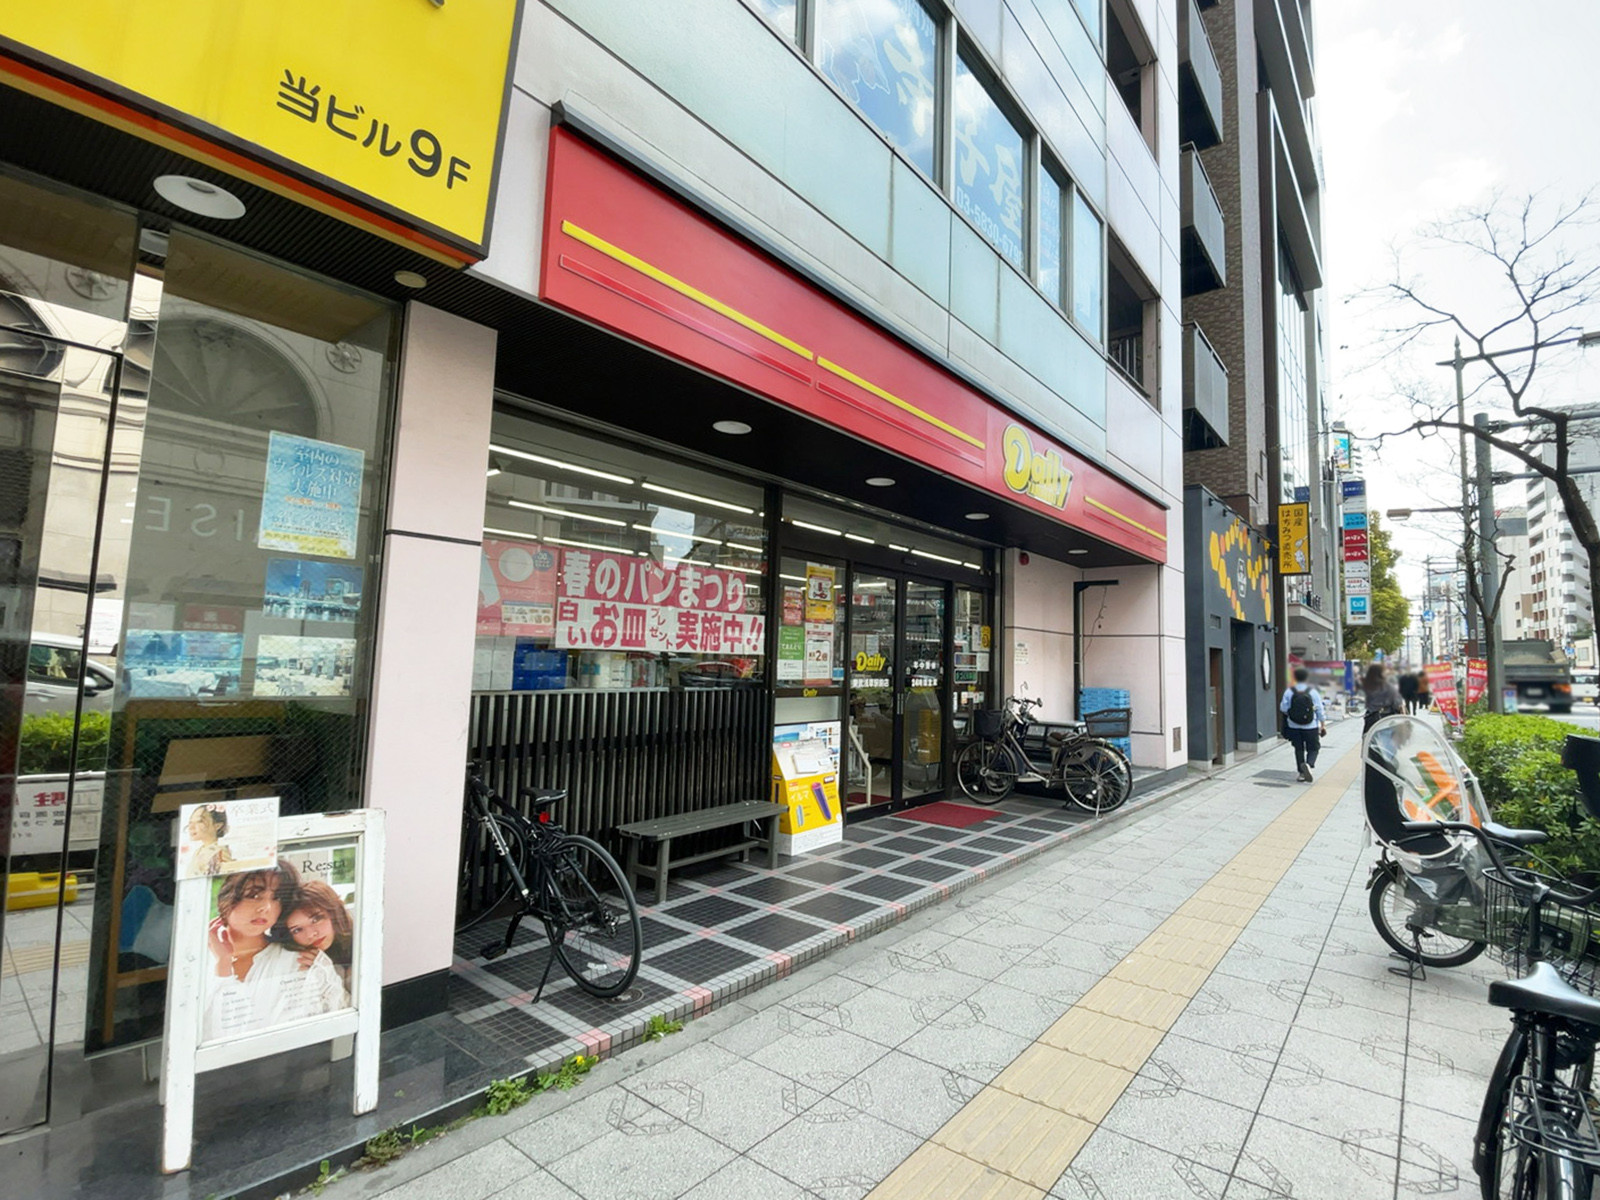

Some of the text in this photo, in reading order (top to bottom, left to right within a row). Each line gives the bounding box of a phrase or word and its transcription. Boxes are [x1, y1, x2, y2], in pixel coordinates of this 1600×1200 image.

[276, 68, 471, 190] 当ビル9F
[1003, 424, 1073, 509] Daily
[563, 551, 745, 612] 春のパンまつり
[855, 651, 886, 672] Daily
